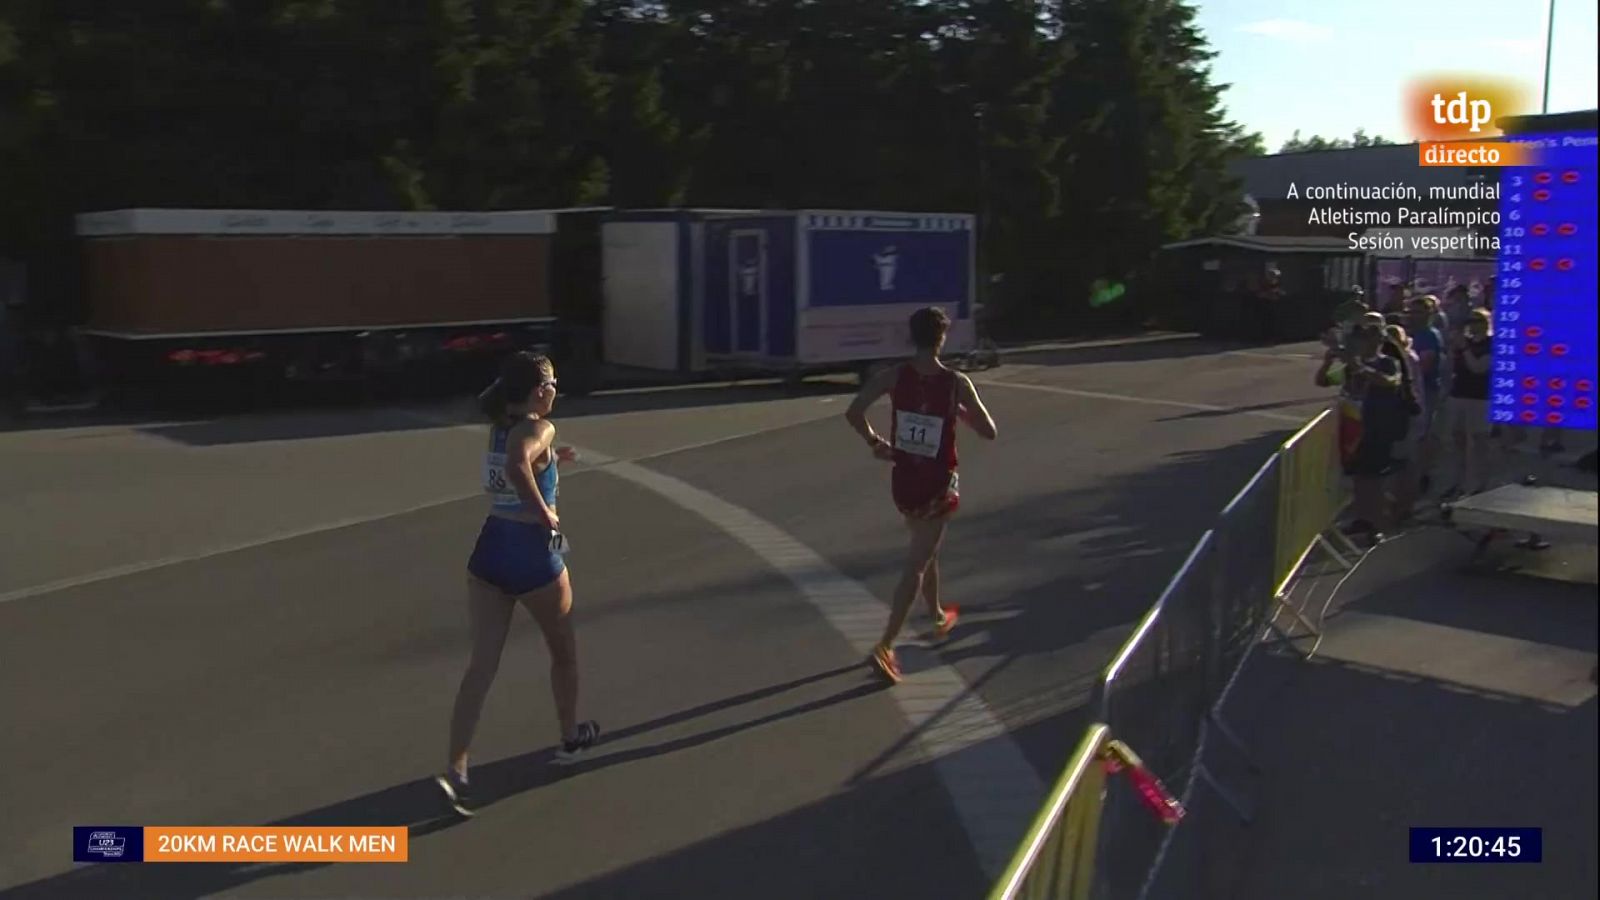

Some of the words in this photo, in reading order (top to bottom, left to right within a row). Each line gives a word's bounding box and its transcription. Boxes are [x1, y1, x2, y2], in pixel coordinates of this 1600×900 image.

[1504, 226, 1525, 238] 10
[1503, 244, 1522, 255] 11
[1502, 260, 1522, 272] 14
[1501, 277, 1521, 289] 16
[1500, 294, 1521, 305] 17
[909, 426, 926, 445] 11
